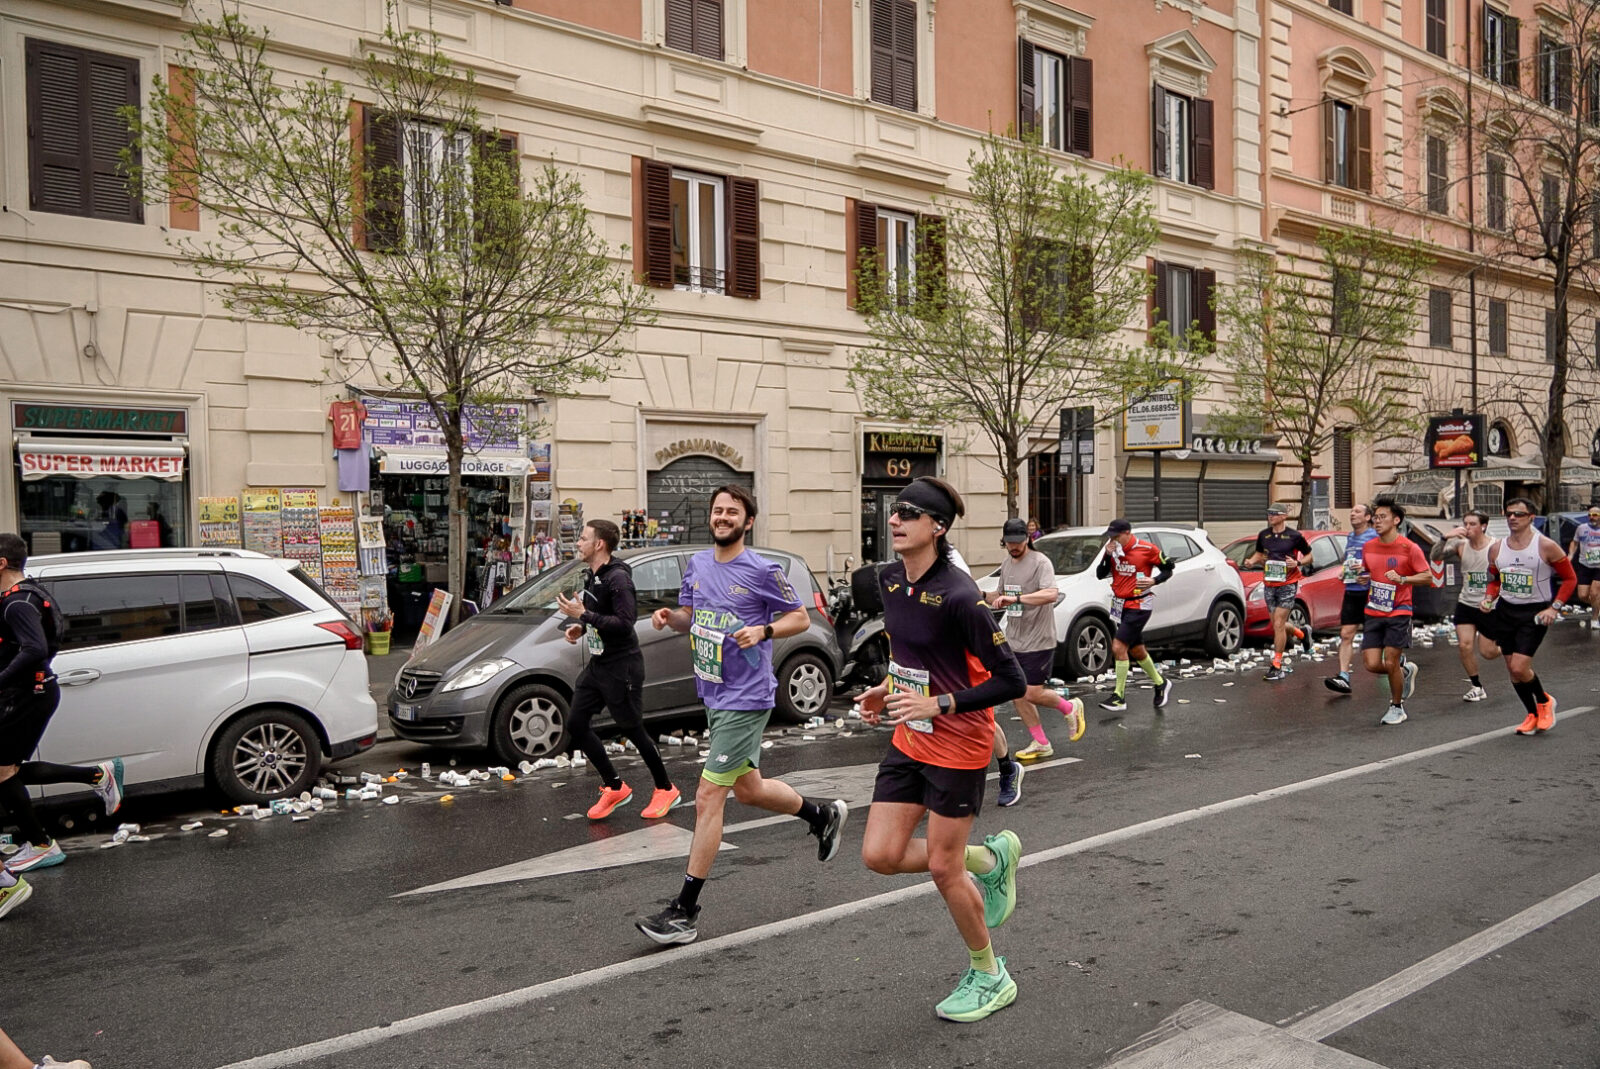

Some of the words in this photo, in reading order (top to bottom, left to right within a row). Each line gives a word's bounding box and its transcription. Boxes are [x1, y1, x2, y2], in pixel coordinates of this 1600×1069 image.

[24, 406, 178, 431] SUPERMARKET
[340, 413, 355, 431] 21
[23, 453, 95, 472] SUPER
[99, 456, 183, 473] MARKET
[400, 461, 449, 471] LUGGAG
[460, 462, 504, 473] TORAGE
[887, 458, 911, 477] 69
[1505, 574, 1527, 585] 15249
